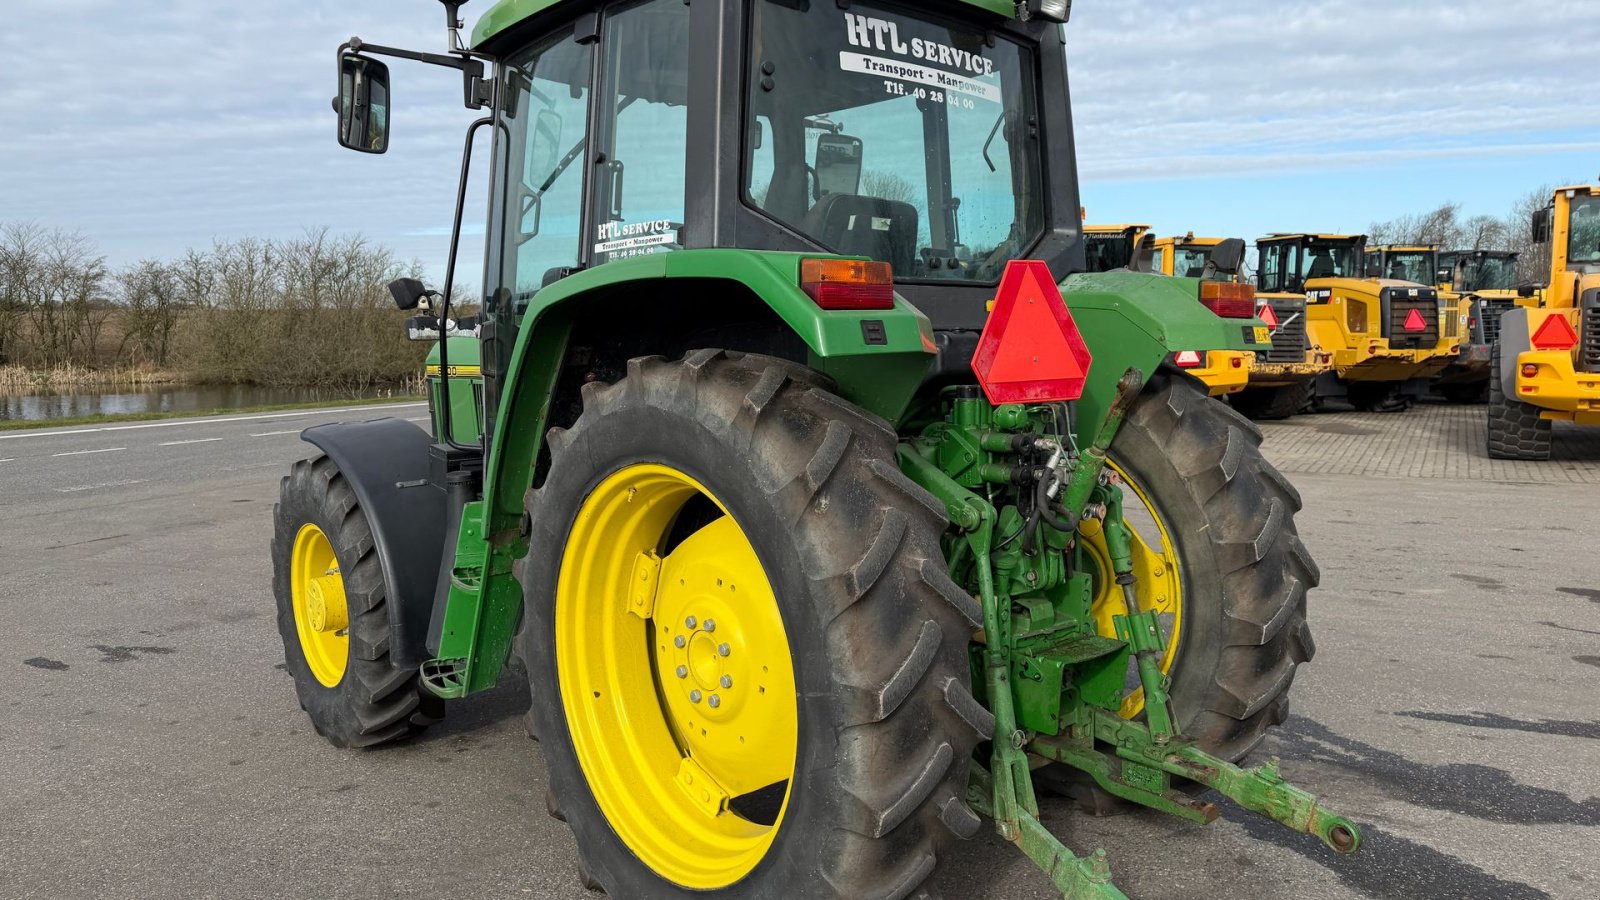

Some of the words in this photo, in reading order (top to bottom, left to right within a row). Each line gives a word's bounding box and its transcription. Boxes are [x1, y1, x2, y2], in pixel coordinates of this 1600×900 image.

[844, 12, 908, 55] HTL
[911, 37, 994, 78] SERVICE
[863, 58, 924, 79] Transport
[937, 72, 987, 95] Manpower
[884, 80, 908, 96] Tlf.
[912, 87, 926, 99] 40
[930, 91, 944, 103] 28
[948, 94, 959, 107] 04
[962, 98, 975, 110] 00
[598, 220, 621, 240] HTL
[622, 219, 671, 236] SERVICE
[602, 240, 627, 250] Transport
[633, 237, 663, 246] Manpower
[1306, 290, 1318, 302] CAT
